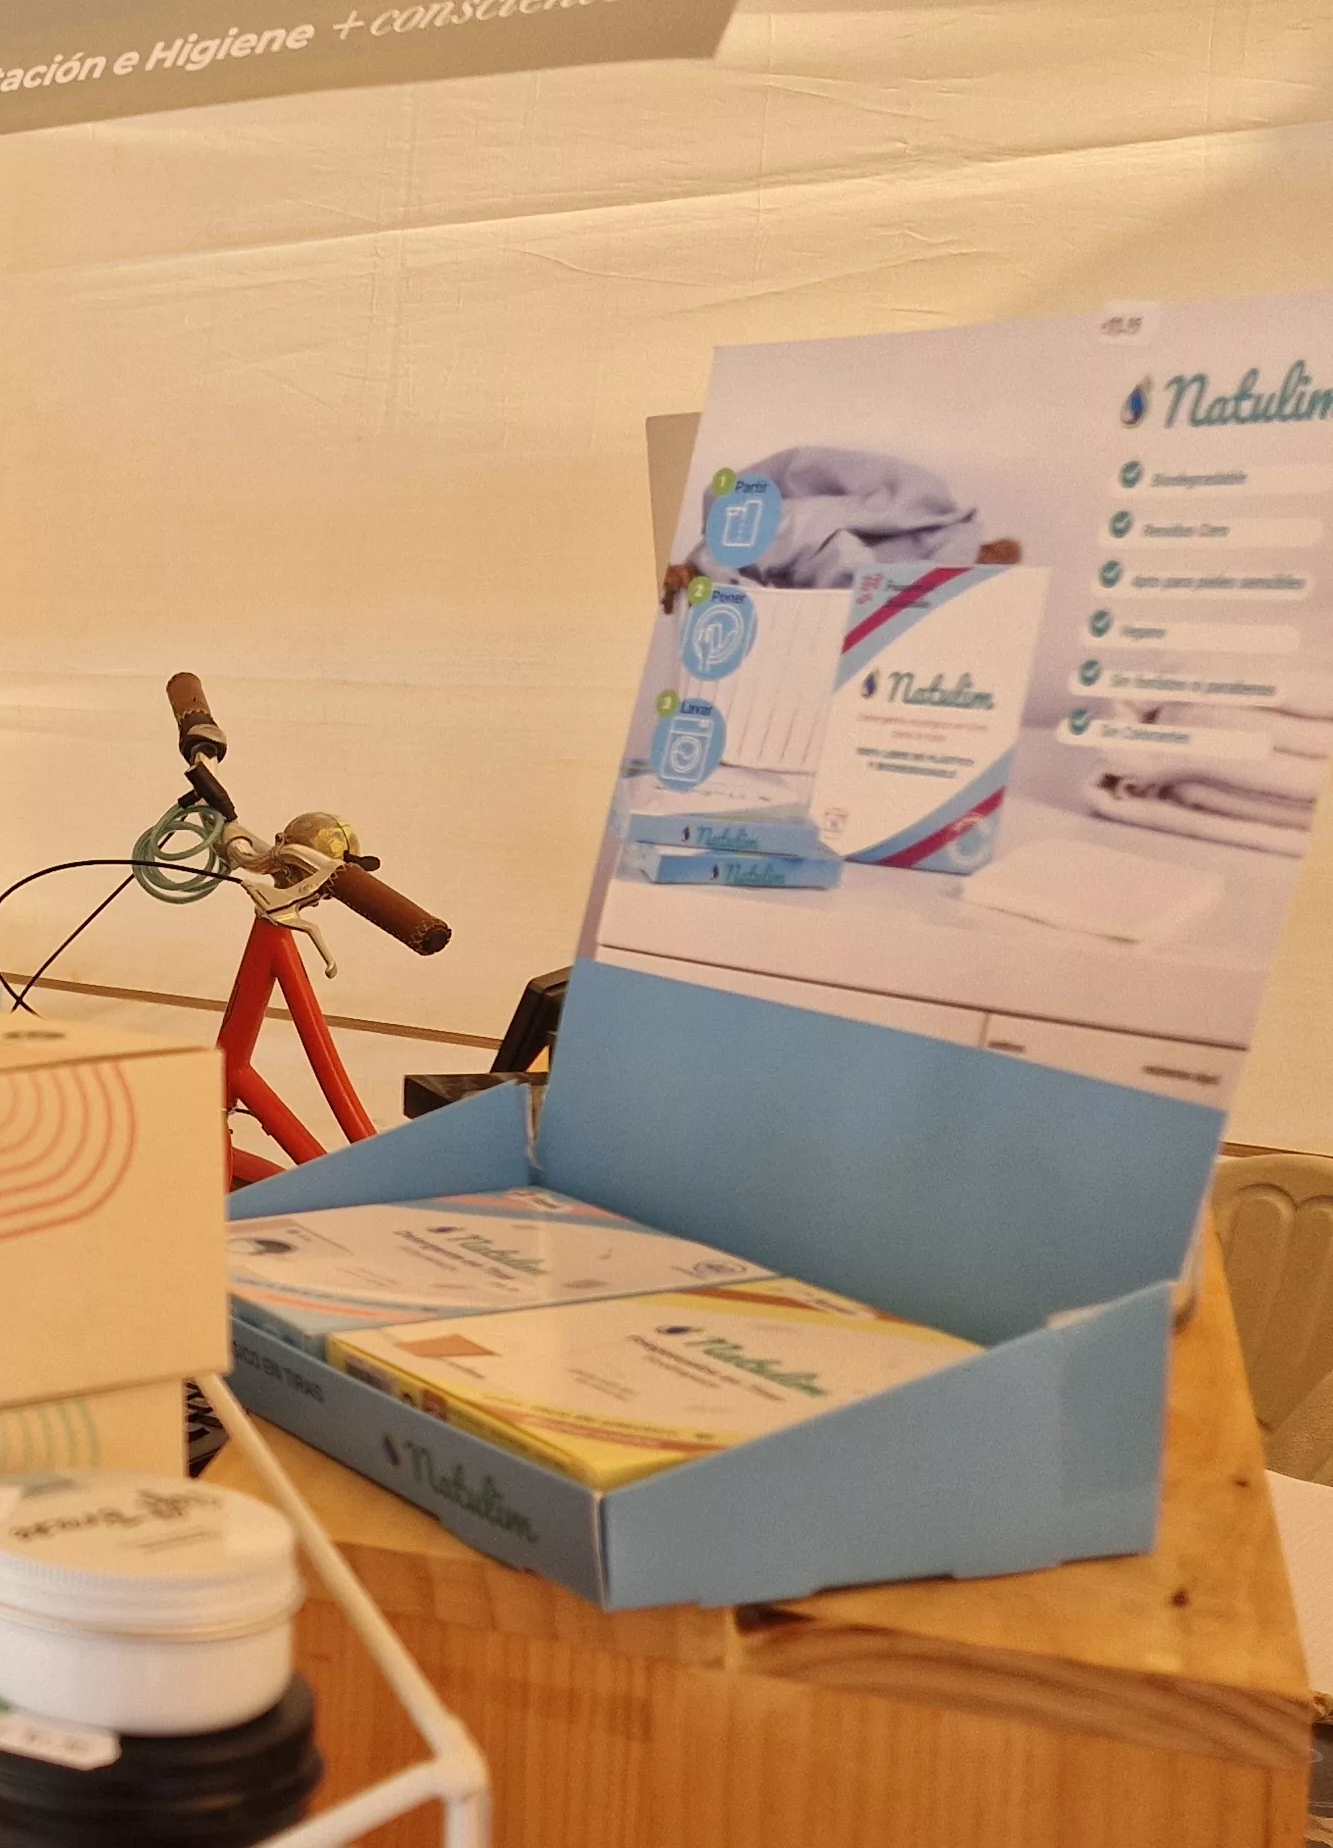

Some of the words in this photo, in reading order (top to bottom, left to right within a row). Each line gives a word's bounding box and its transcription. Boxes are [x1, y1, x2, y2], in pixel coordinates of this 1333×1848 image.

[113, 49, 138, 75] e
[145, 24, 314, 71] Higiene
[735, 480, 768, 495] Partir
[712, 590, 746, 604] Poner
[680, 703, 713, 717] Lavar
